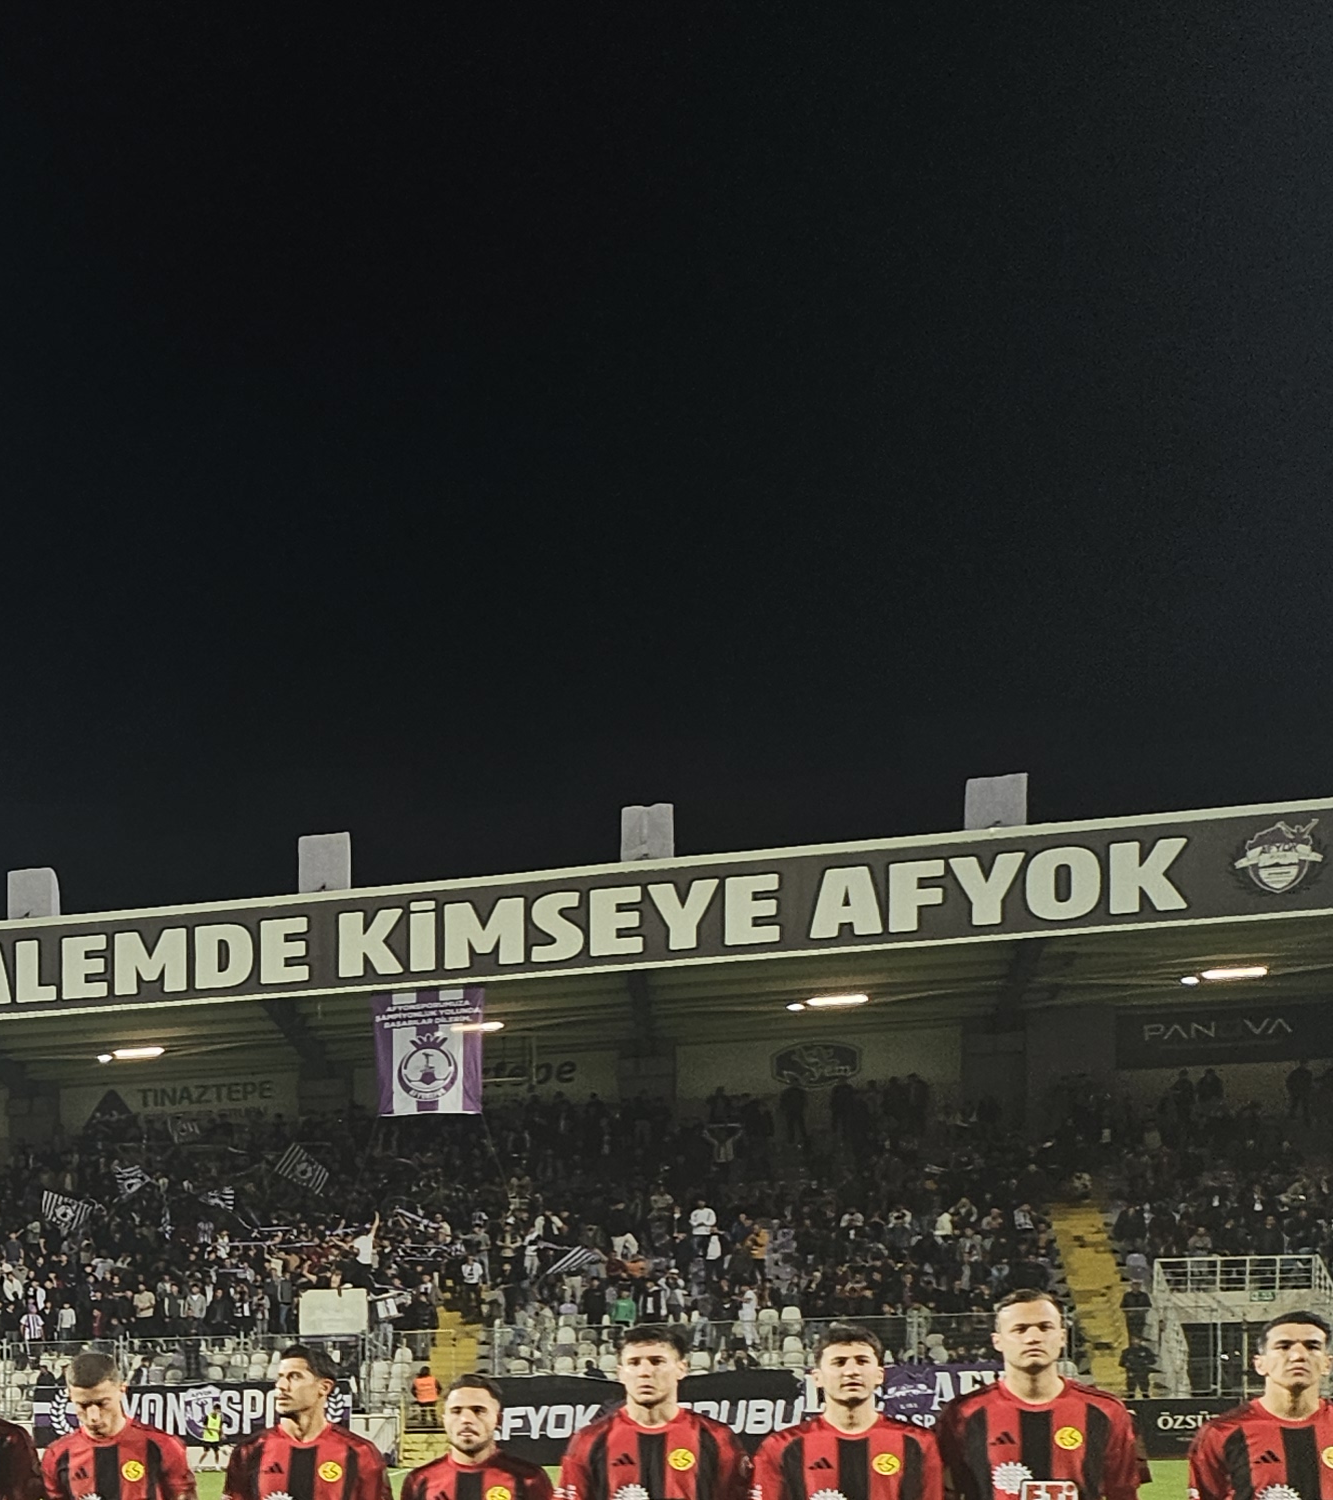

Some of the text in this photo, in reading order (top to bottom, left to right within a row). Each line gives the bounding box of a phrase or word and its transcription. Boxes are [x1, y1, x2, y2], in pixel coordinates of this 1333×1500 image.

[337, 872, 781, 979] KİMSEYE
[810, 836, 1189, 939] AFYOK
[137, 1080, 275, 1108] TINAZTEPE
[493, 1404, 602, 1441] FYOK
